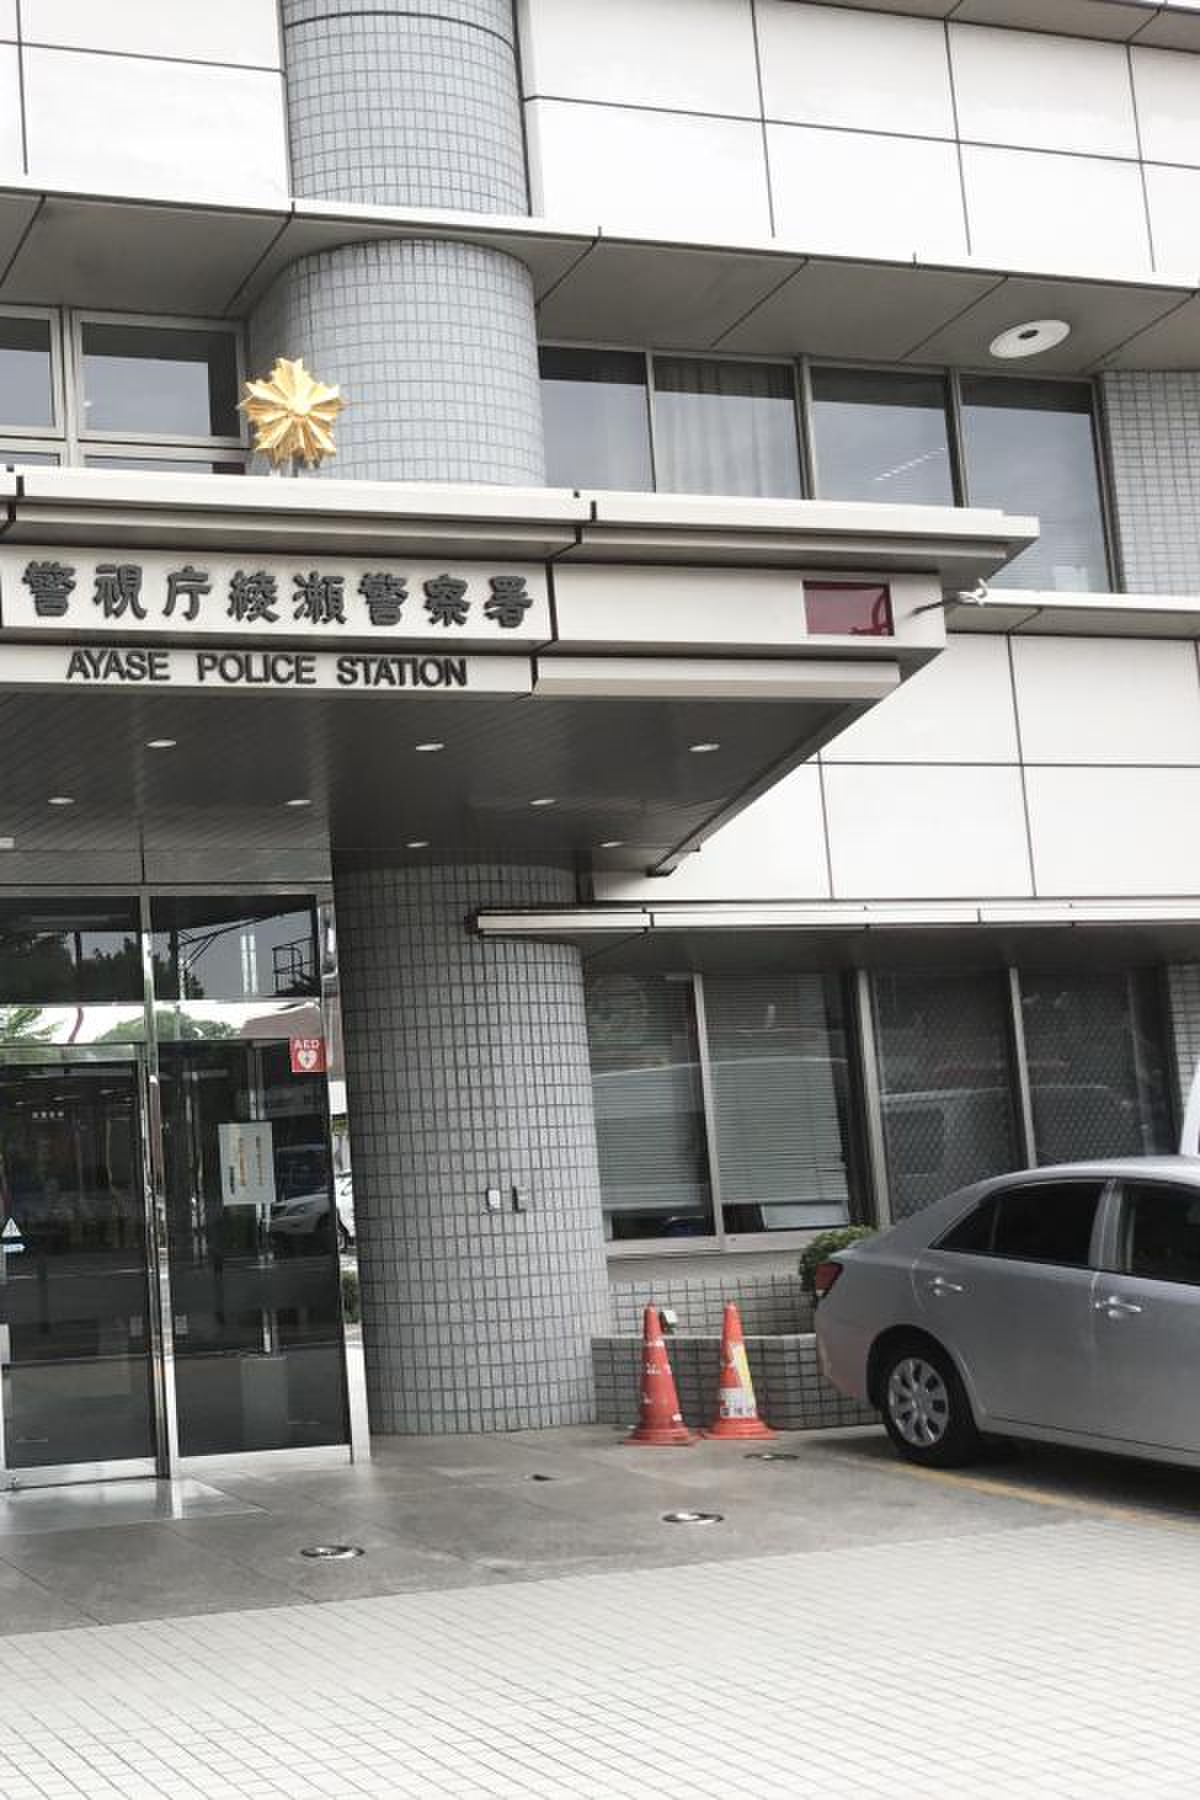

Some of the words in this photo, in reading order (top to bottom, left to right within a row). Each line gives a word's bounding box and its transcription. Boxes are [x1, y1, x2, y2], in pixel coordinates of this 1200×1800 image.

[22, 560, 533, 629] 警視庁綾瀬警察署
[65, 649, 170, 682] AYASE
[197, 653, 317, 686] POLICE
[336, 657, 468, 687] STATION
[293, 1039, 320, 1050] AED
